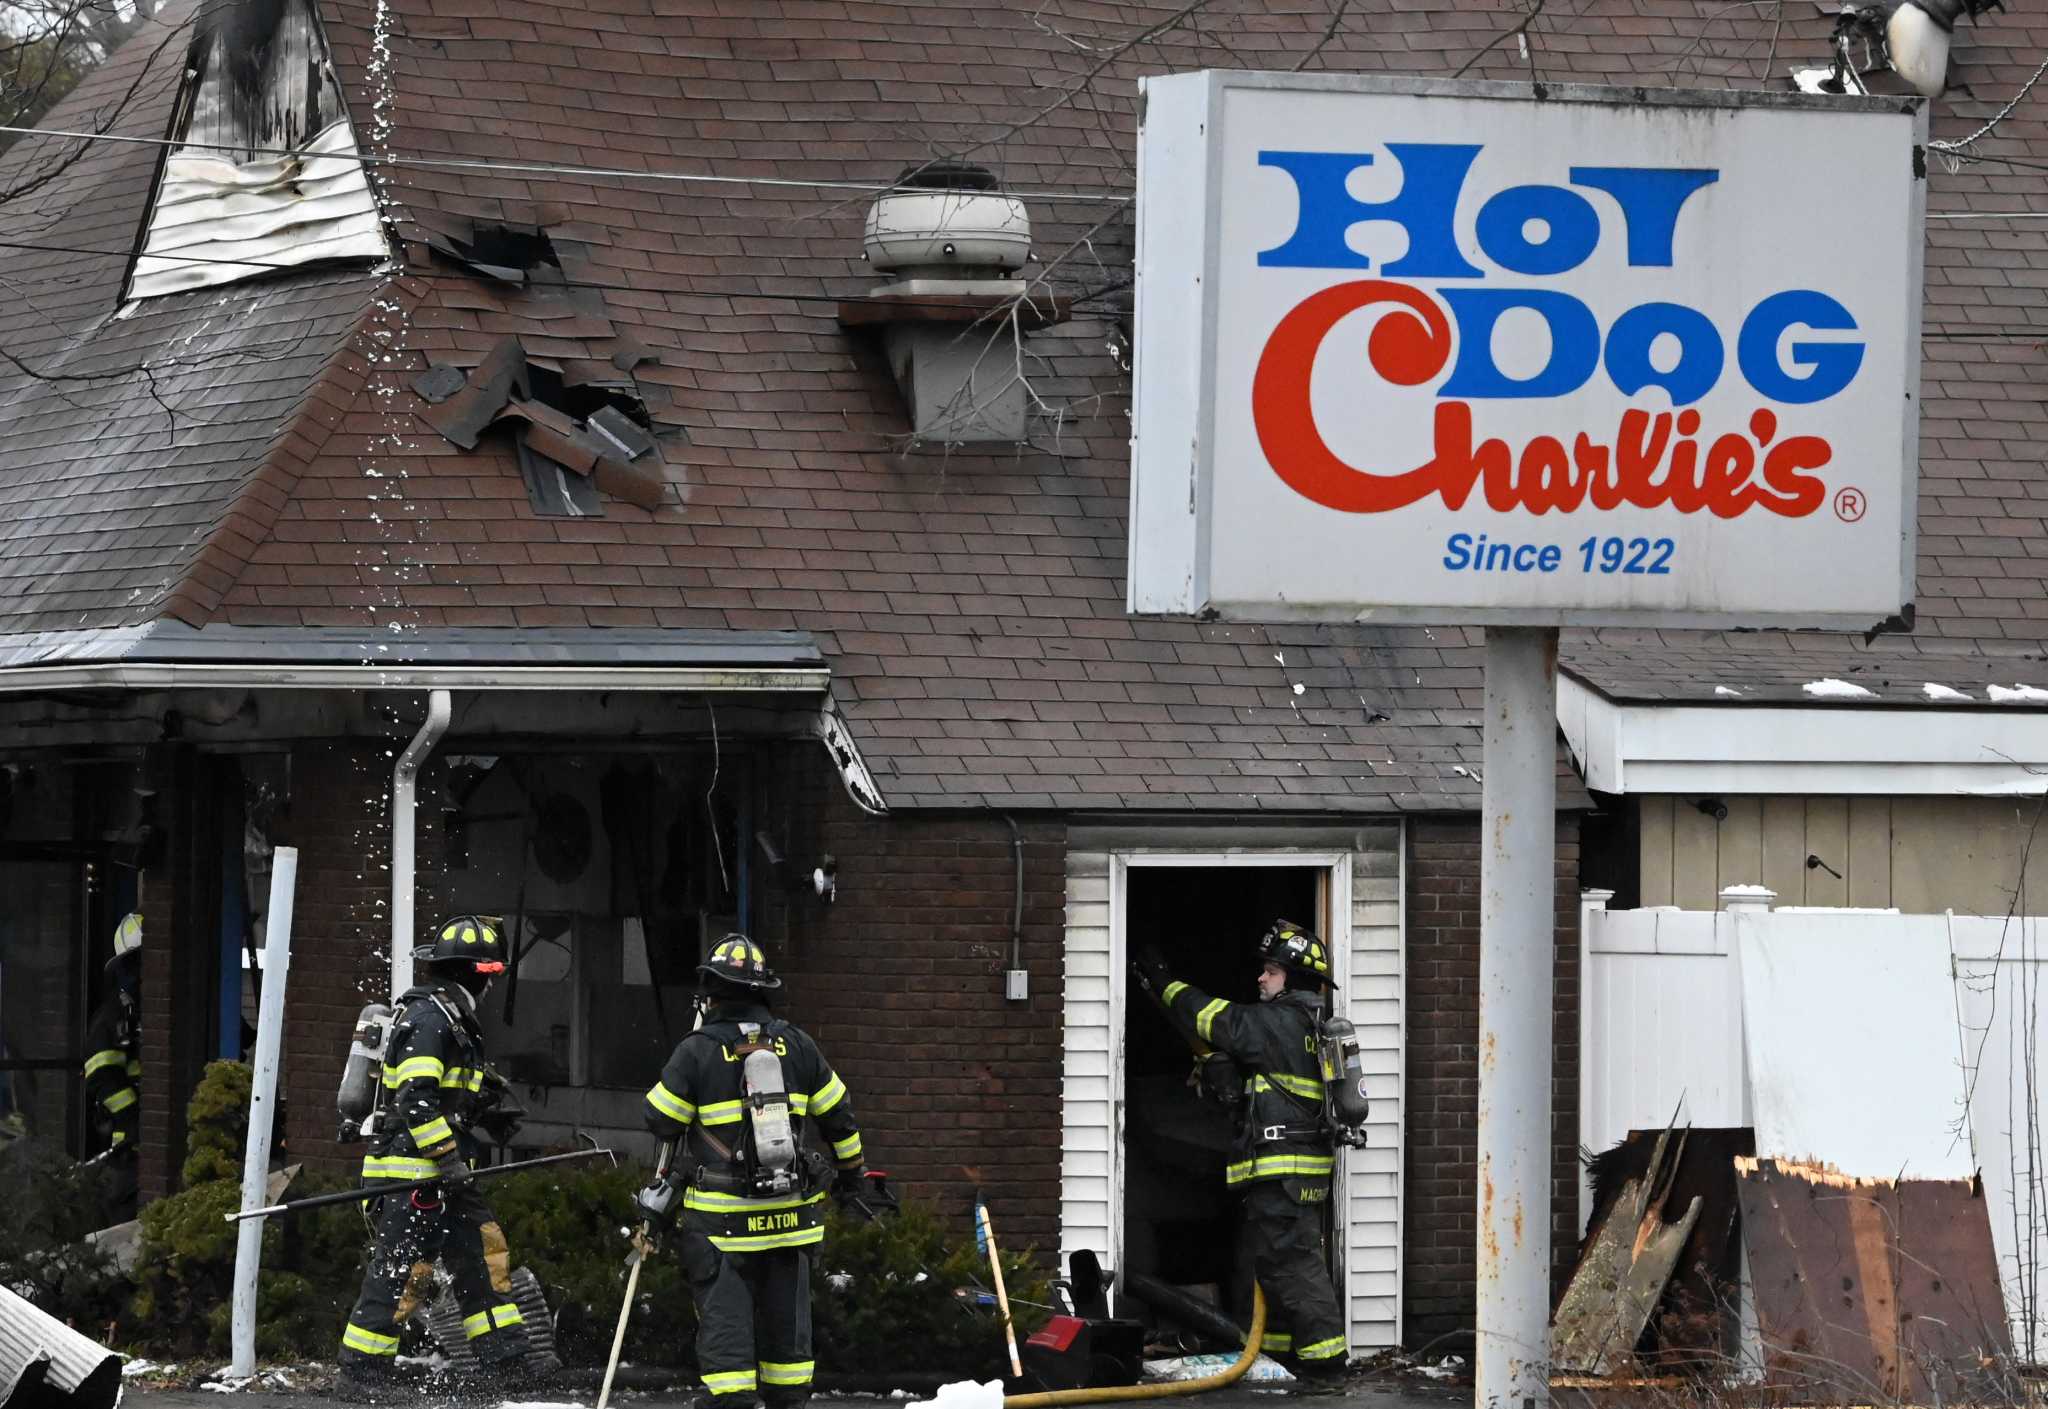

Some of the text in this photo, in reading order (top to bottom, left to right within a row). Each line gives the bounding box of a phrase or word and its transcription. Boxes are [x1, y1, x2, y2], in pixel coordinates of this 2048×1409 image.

[1252, 279, 1832, 519] Charlie's
[1443, 533, 1675, 575] Since 1922
[748, 1211, 798, 1232] NEATON
